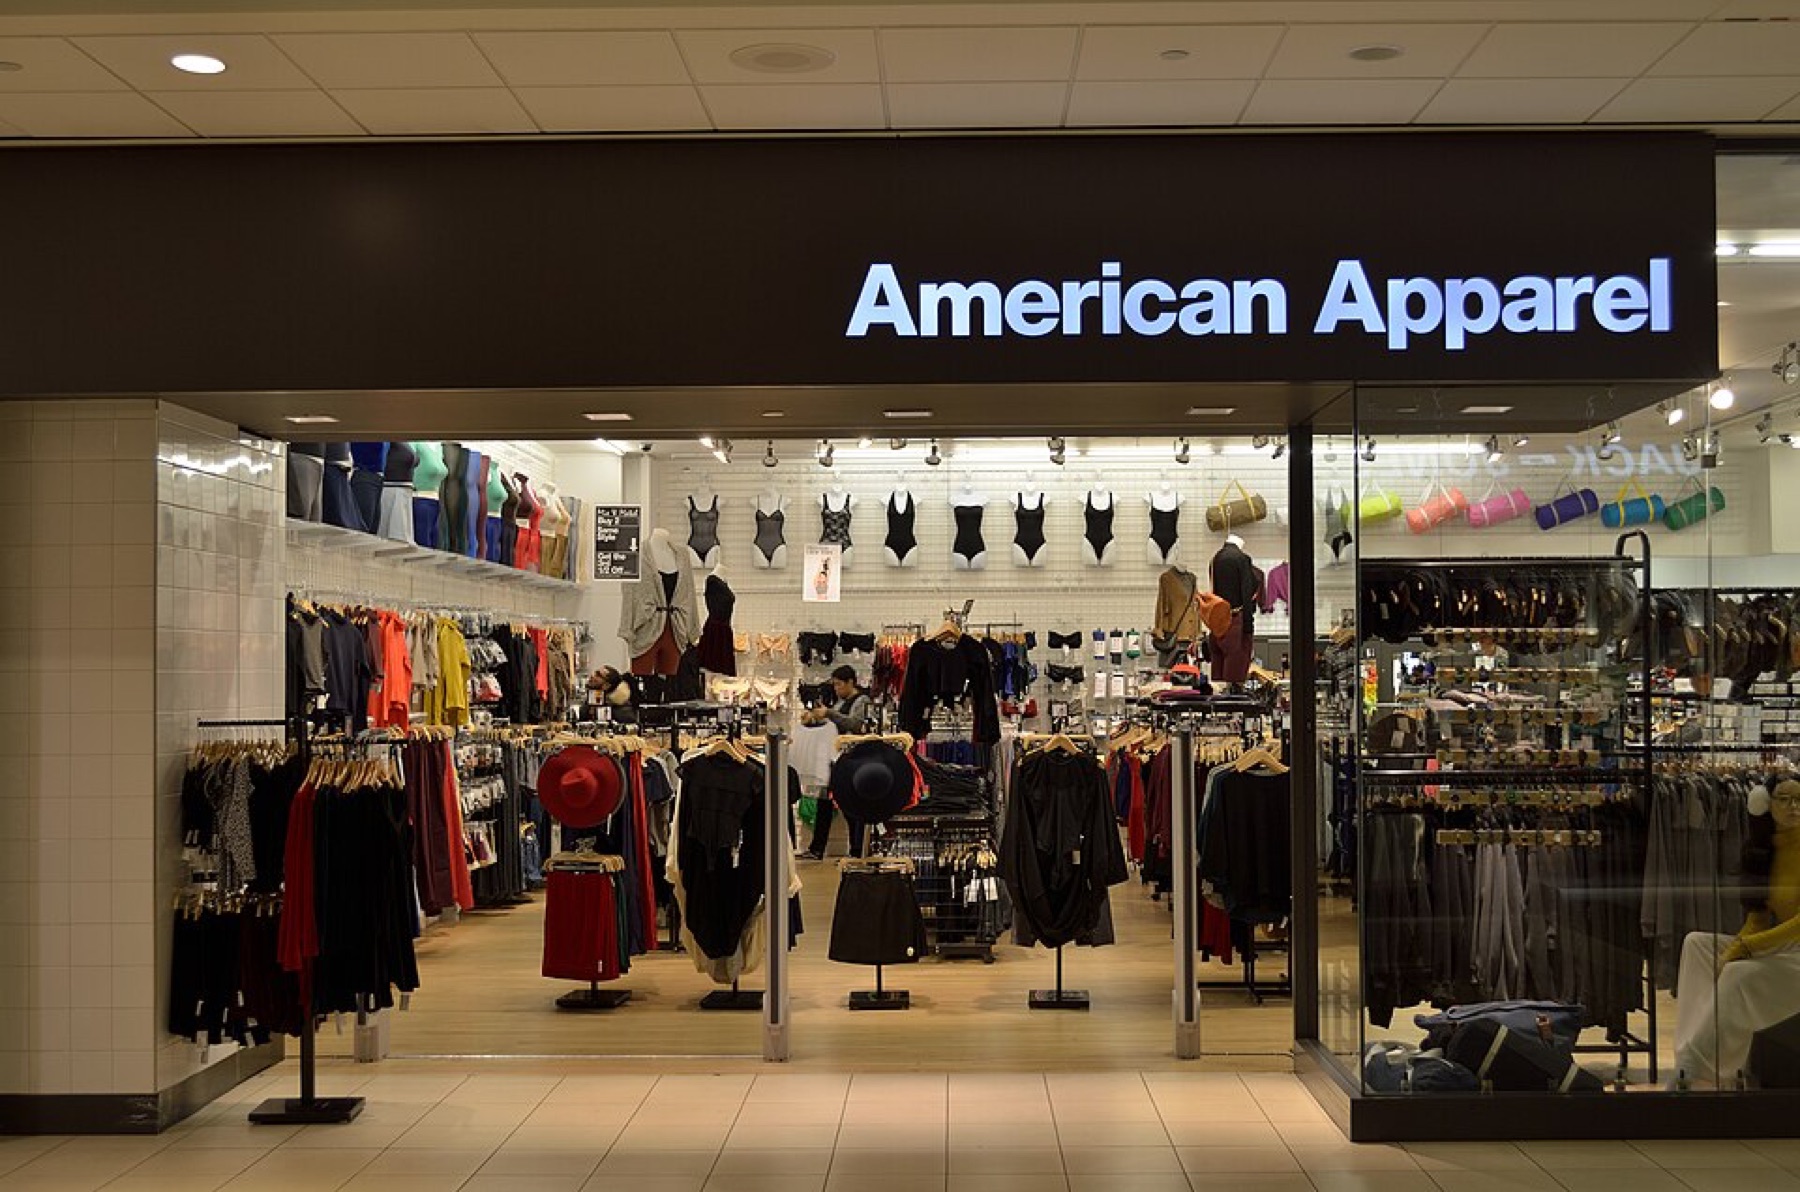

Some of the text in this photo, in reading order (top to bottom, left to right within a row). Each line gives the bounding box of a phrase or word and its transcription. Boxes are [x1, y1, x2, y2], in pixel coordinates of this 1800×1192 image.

[846, 257, 1672, 350] American Apparel
[597, 516, 614, 526] Buy
